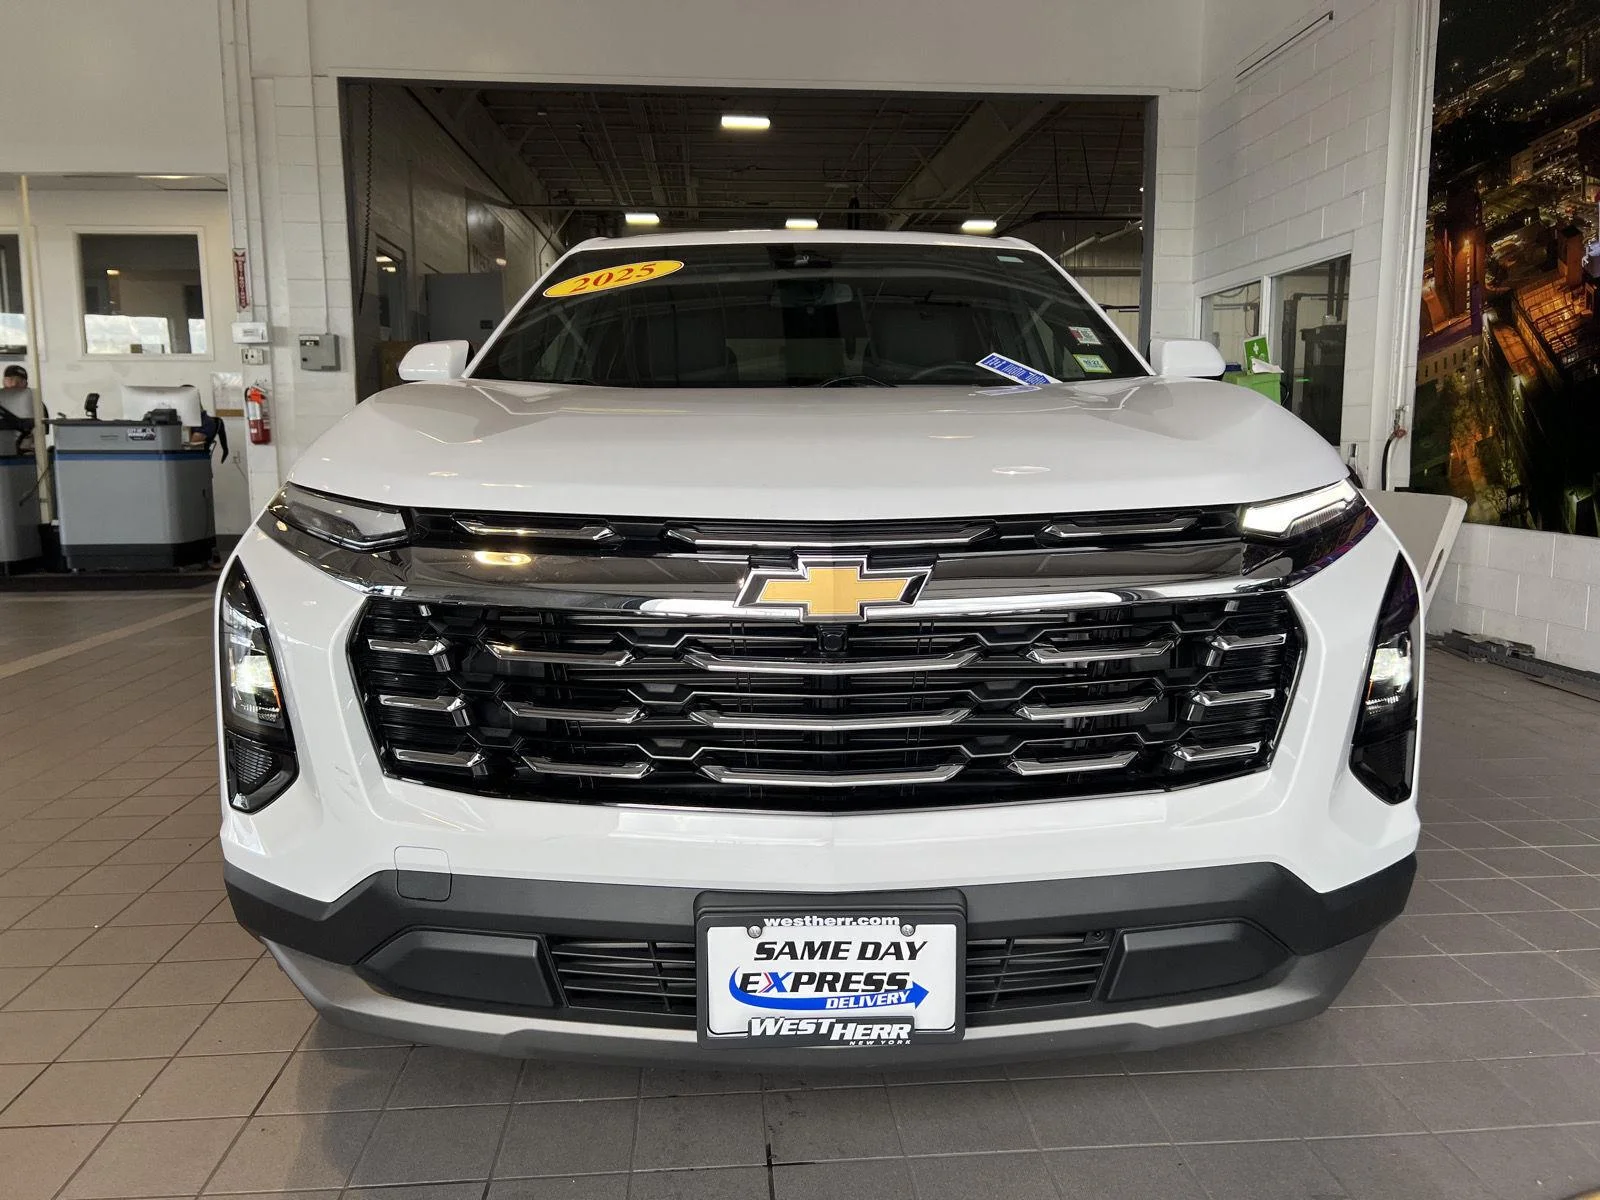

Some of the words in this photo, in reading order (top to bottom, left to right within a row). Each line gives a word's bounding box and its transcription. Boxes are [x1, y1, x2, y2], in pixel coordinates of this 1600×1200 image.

[570, 263, 656, 293] 2025
[764, 915, 900, 927] westherr.com
[754, 941, 851, 961] SAME
[856, 941, 928, 961] DAY
[739, 972, 910, 993] EXPRESS
[825, 991, 911, 1009] DELIVERY
[751, 1017, 836, 1036] WEST
[830, 1022, 912, 1041] HERR
